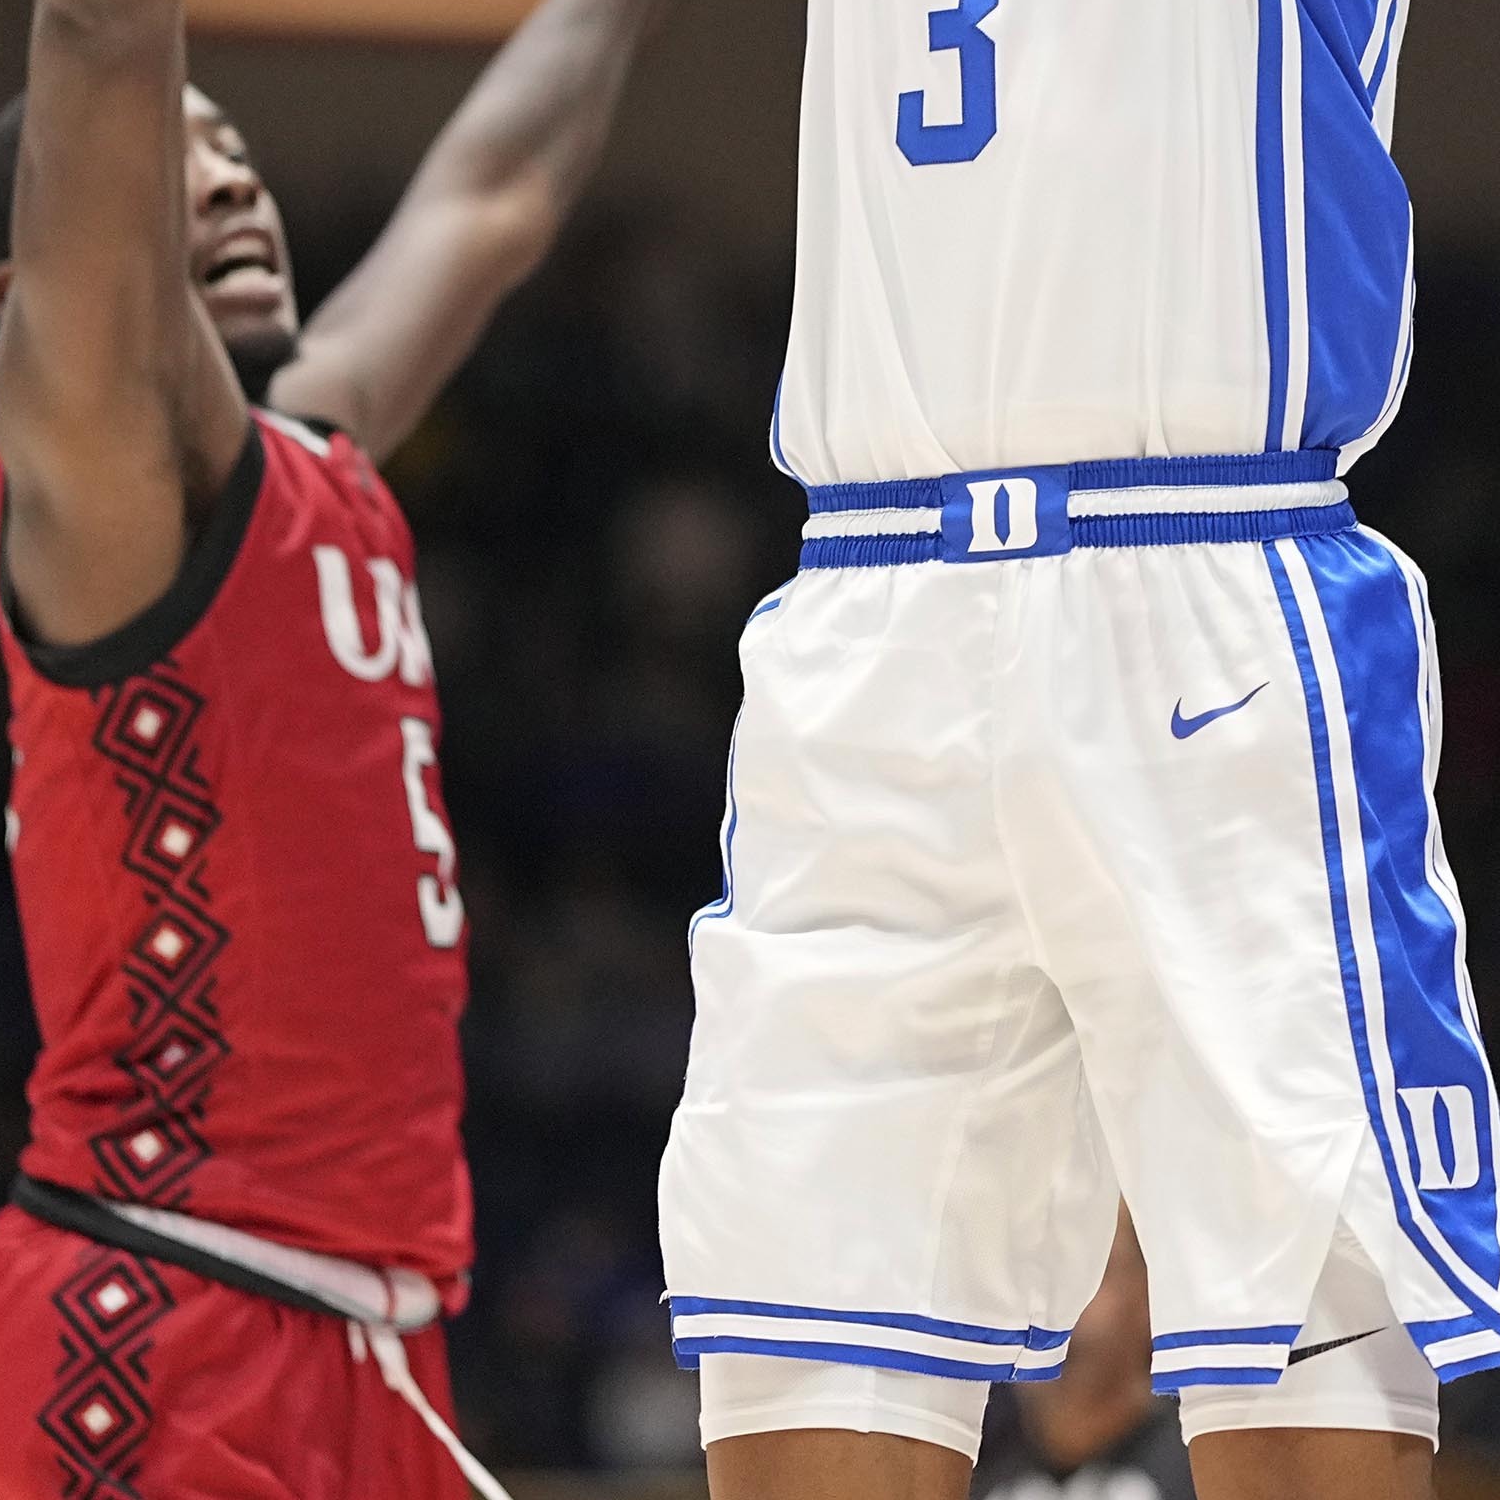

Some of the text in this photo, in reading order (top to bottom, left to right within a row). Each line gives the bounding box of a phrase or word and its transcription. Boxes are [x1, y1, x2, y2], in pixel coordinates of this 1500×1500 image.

[966, 477, 1038, 553] D
[401, 716, 464, 948] 5
[1396, 1084, 1481, 1191] D
